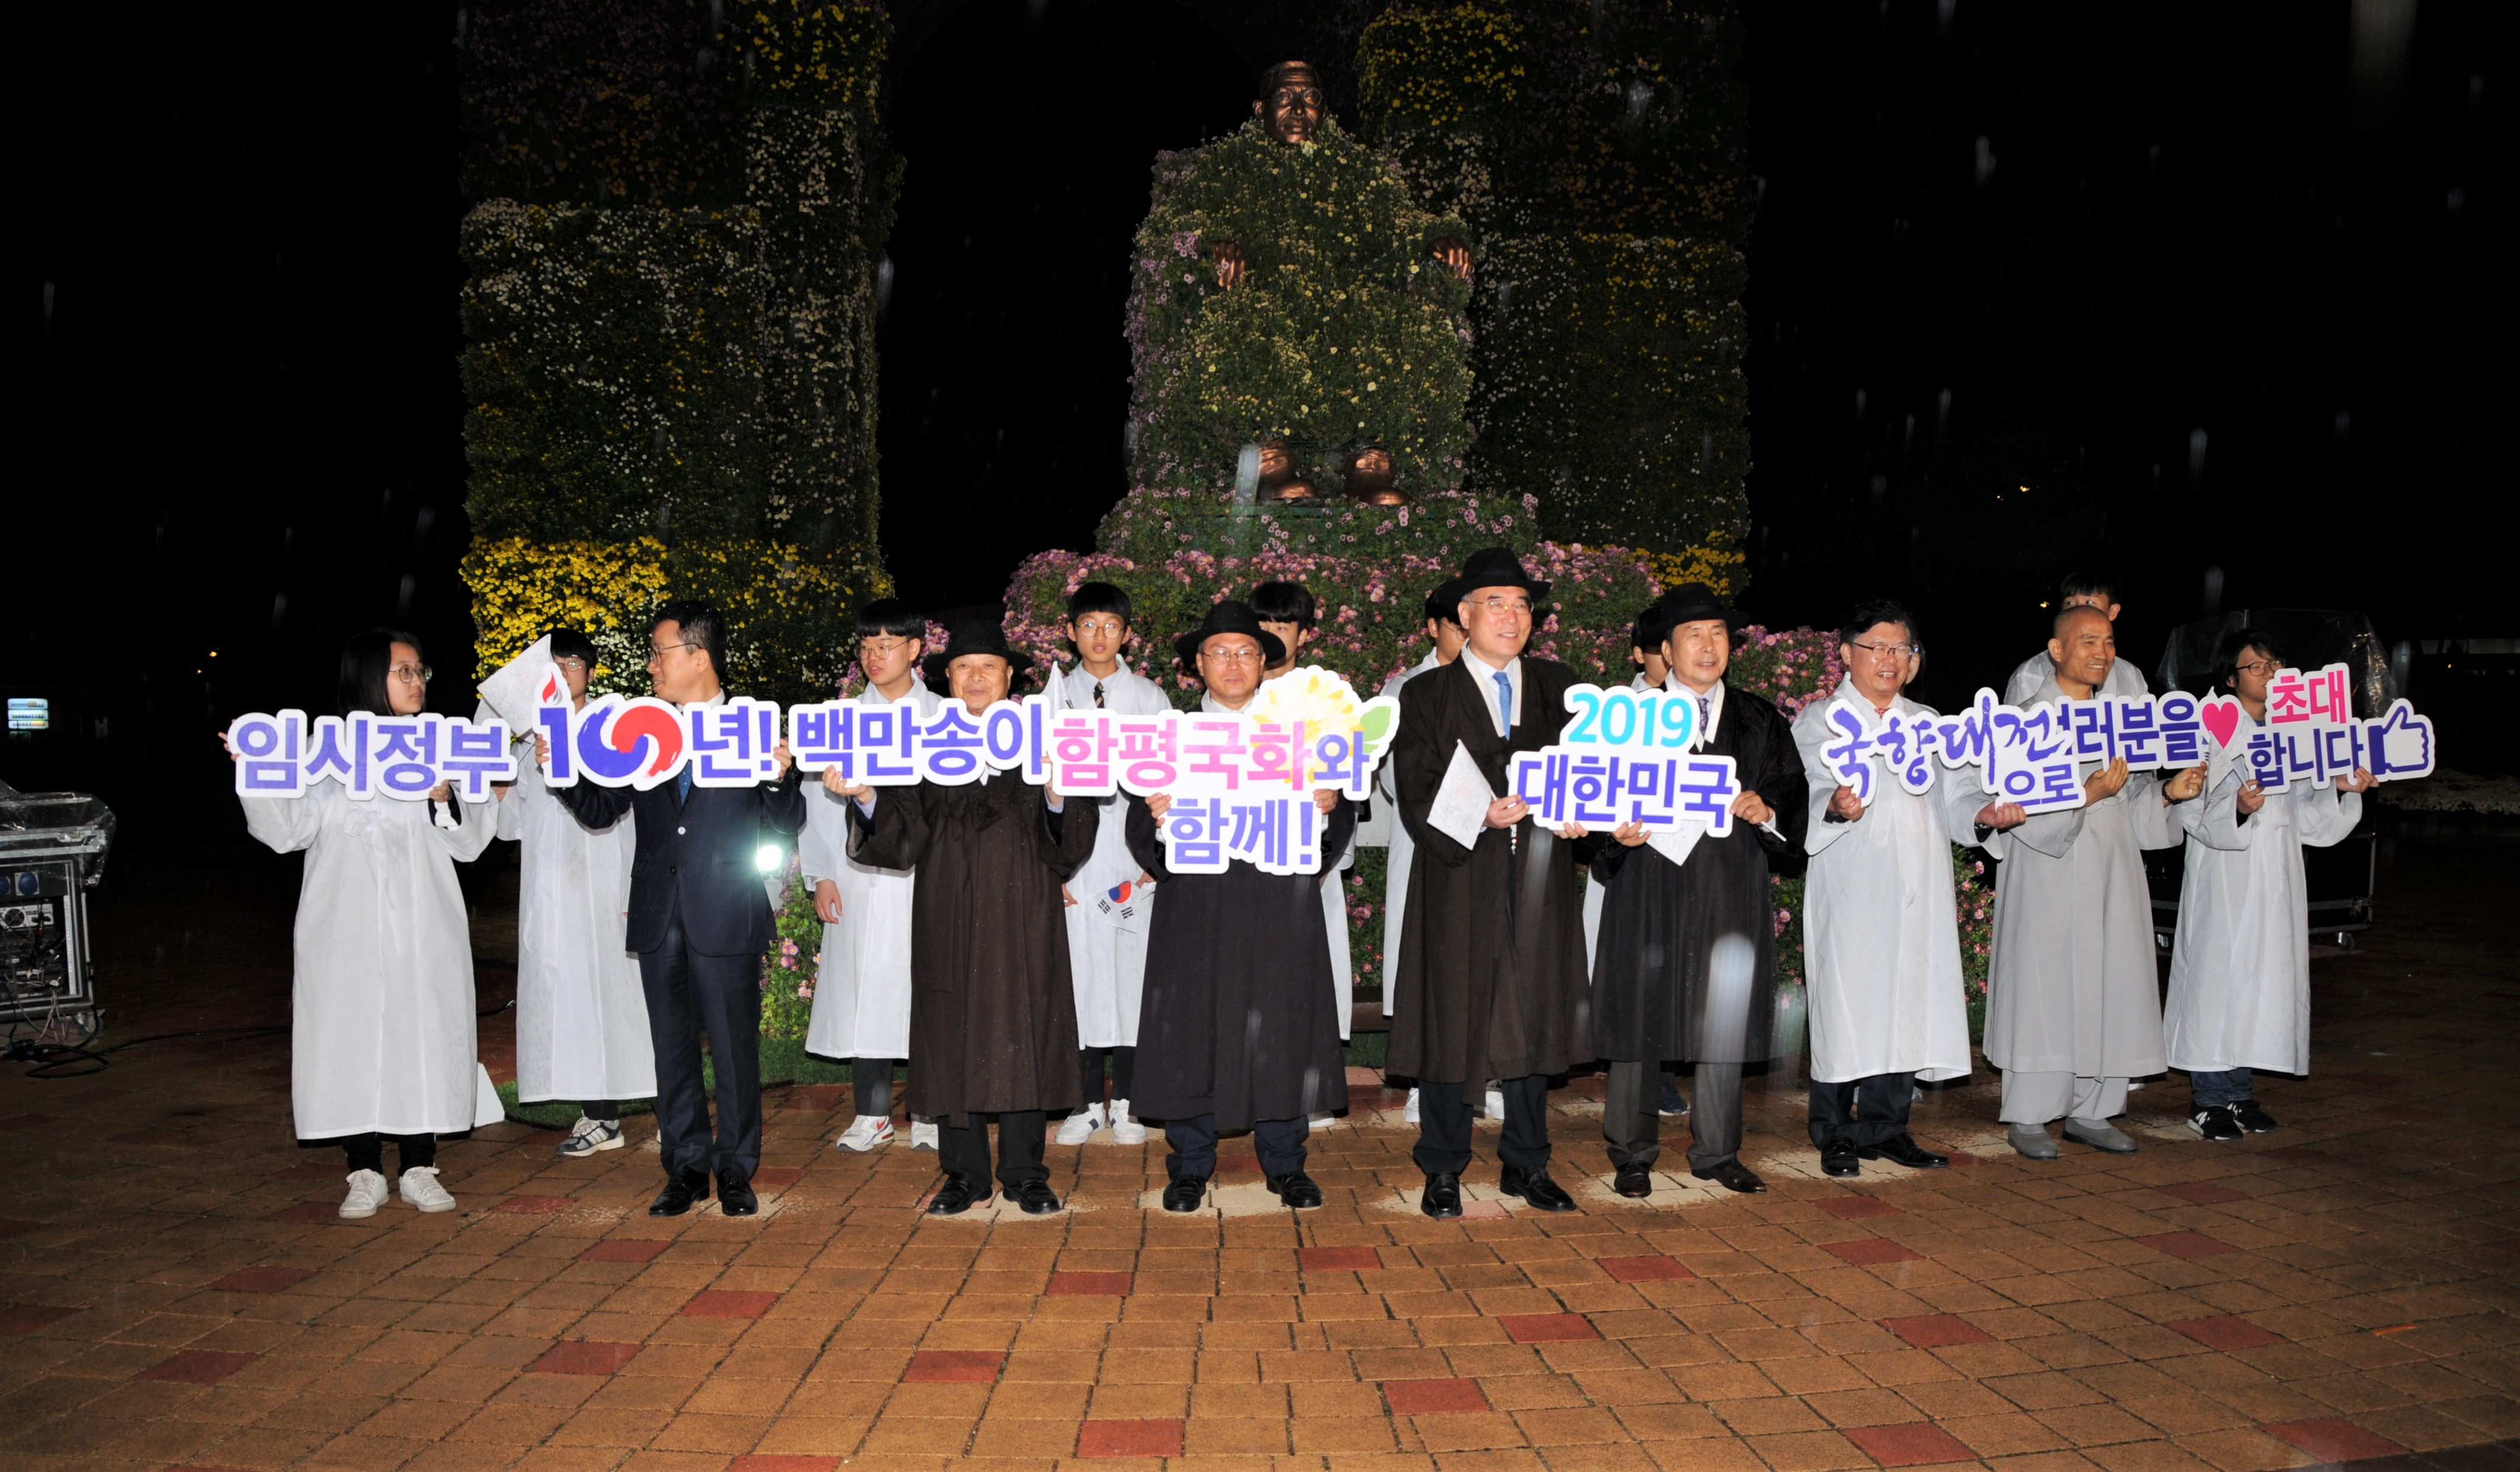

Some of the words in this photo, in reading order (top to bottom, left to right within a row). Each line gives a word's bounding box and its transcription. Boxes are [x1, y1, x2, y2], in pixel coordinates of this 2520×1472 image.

[1568, 692, 1693, 748] 2019
[2271, 670, 2347, 724] 초대
[237, 717, 509, 794] 임시정부
[797, 703, 1042, 779] 백만송이
[1053, 717, 1370, 791] 함평국화와
[2247, 724, 2364, 787] 합니다
[1517, 753, 1733, 828] 대한민국
[2004, 763, 2079, 806] 으로
[1167, 798, 1314, 866] 함께!
